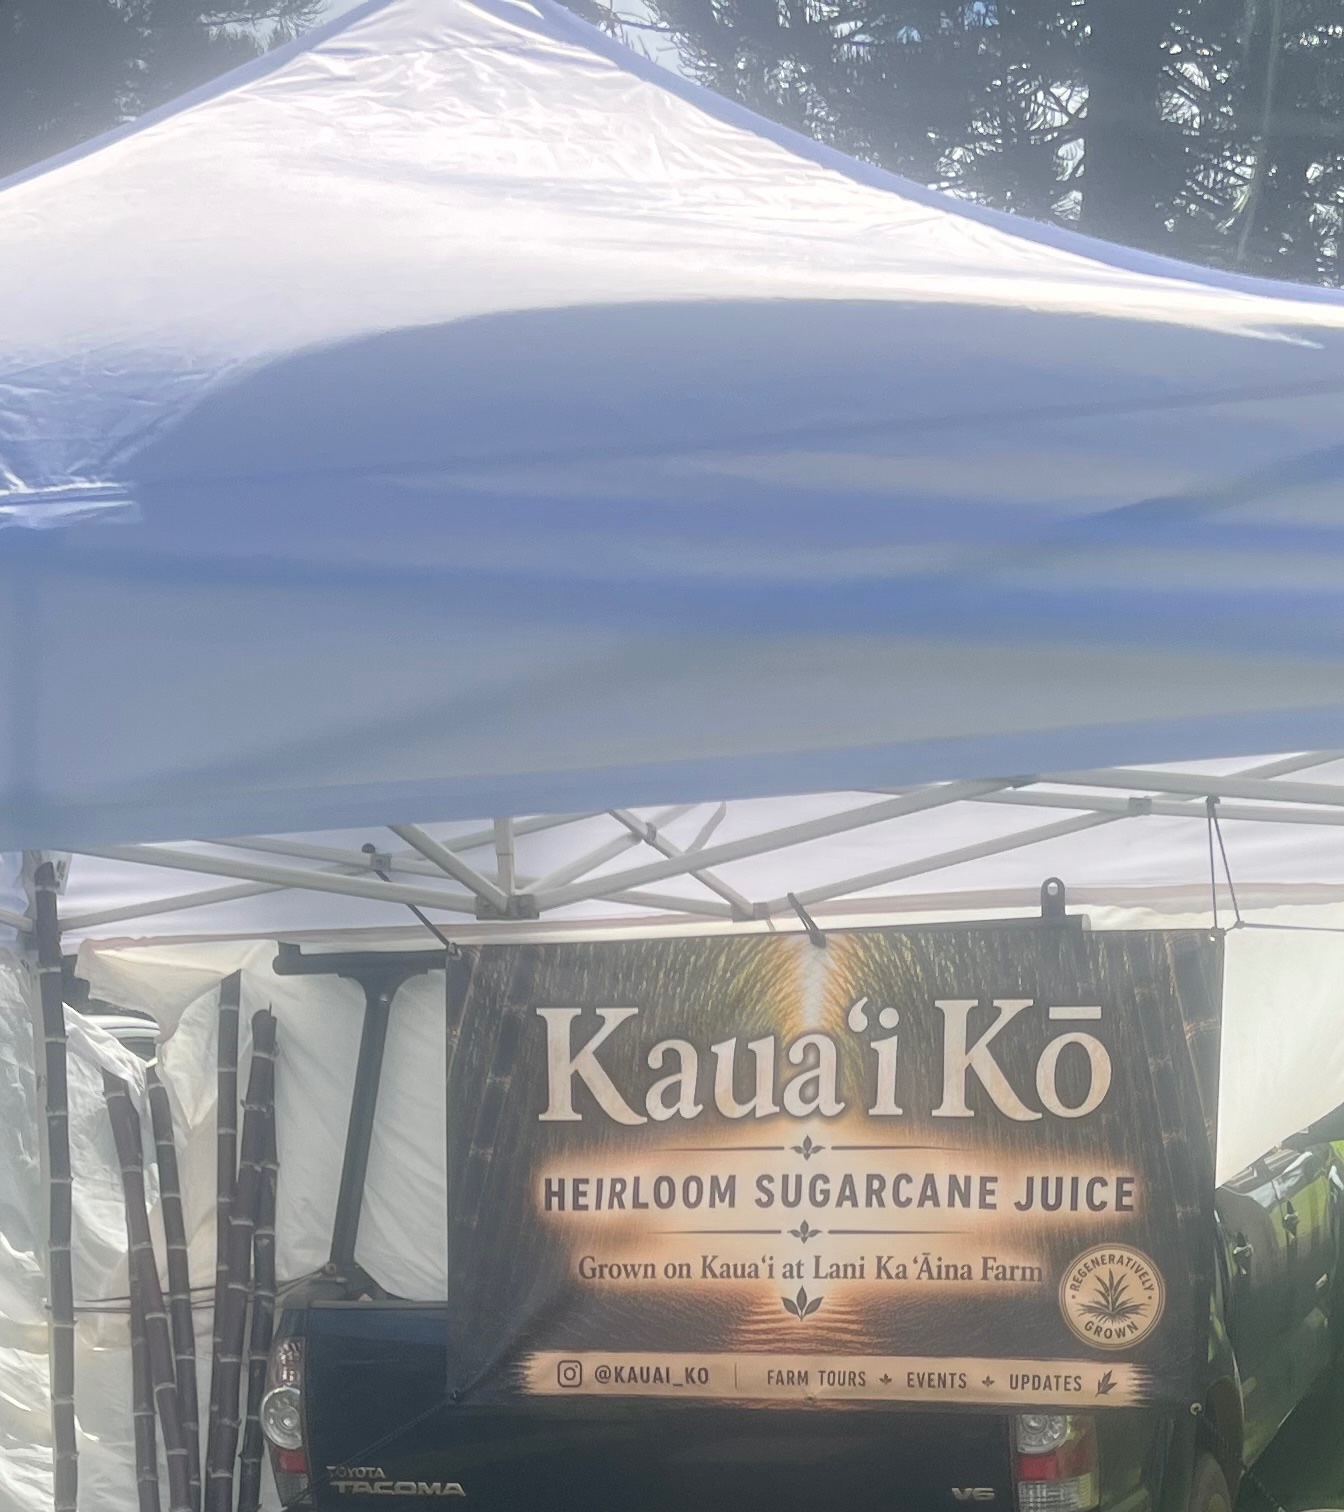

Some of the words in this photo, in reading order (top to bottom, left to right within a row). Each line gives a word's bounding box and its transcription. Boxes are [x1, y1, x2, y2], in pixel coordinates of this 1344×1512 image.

[931, 998, 1113, 1122] Kō
[544, 1174, 737, 1211] HEIRLOOM
[754, 1173, 999, 1210] SUGARCANE
[1014, 1176, 1136, 1212] JUICE
[578, 1255, 657, 1280] Grown
[663, 1262, 693, 1280] on
[781, 1260, 805, 1280] at
[812, 1255, 866, 1280] Lani
[981, 1255, 1044, 1282] Farm
[1069, 1253, 1155, 1292] REGENERATIVELY
[1084, 1320, 1139, 1340] GROWN
[594, 1364, 710, 1388] @KAUAI_KO
[767, 1369, 809, 1387] FARM
[817, 1369, 867, 1387] TOURS
[906, 1371, 968, 1389] EVENTS
[1009, 1373, 1082, 1392] UPDATES
[326, 1465, 386, 1479] TOYOTA
[330, 1480, 467, 1497] TACOMA
[951, 1487, 996, 1500] V6
